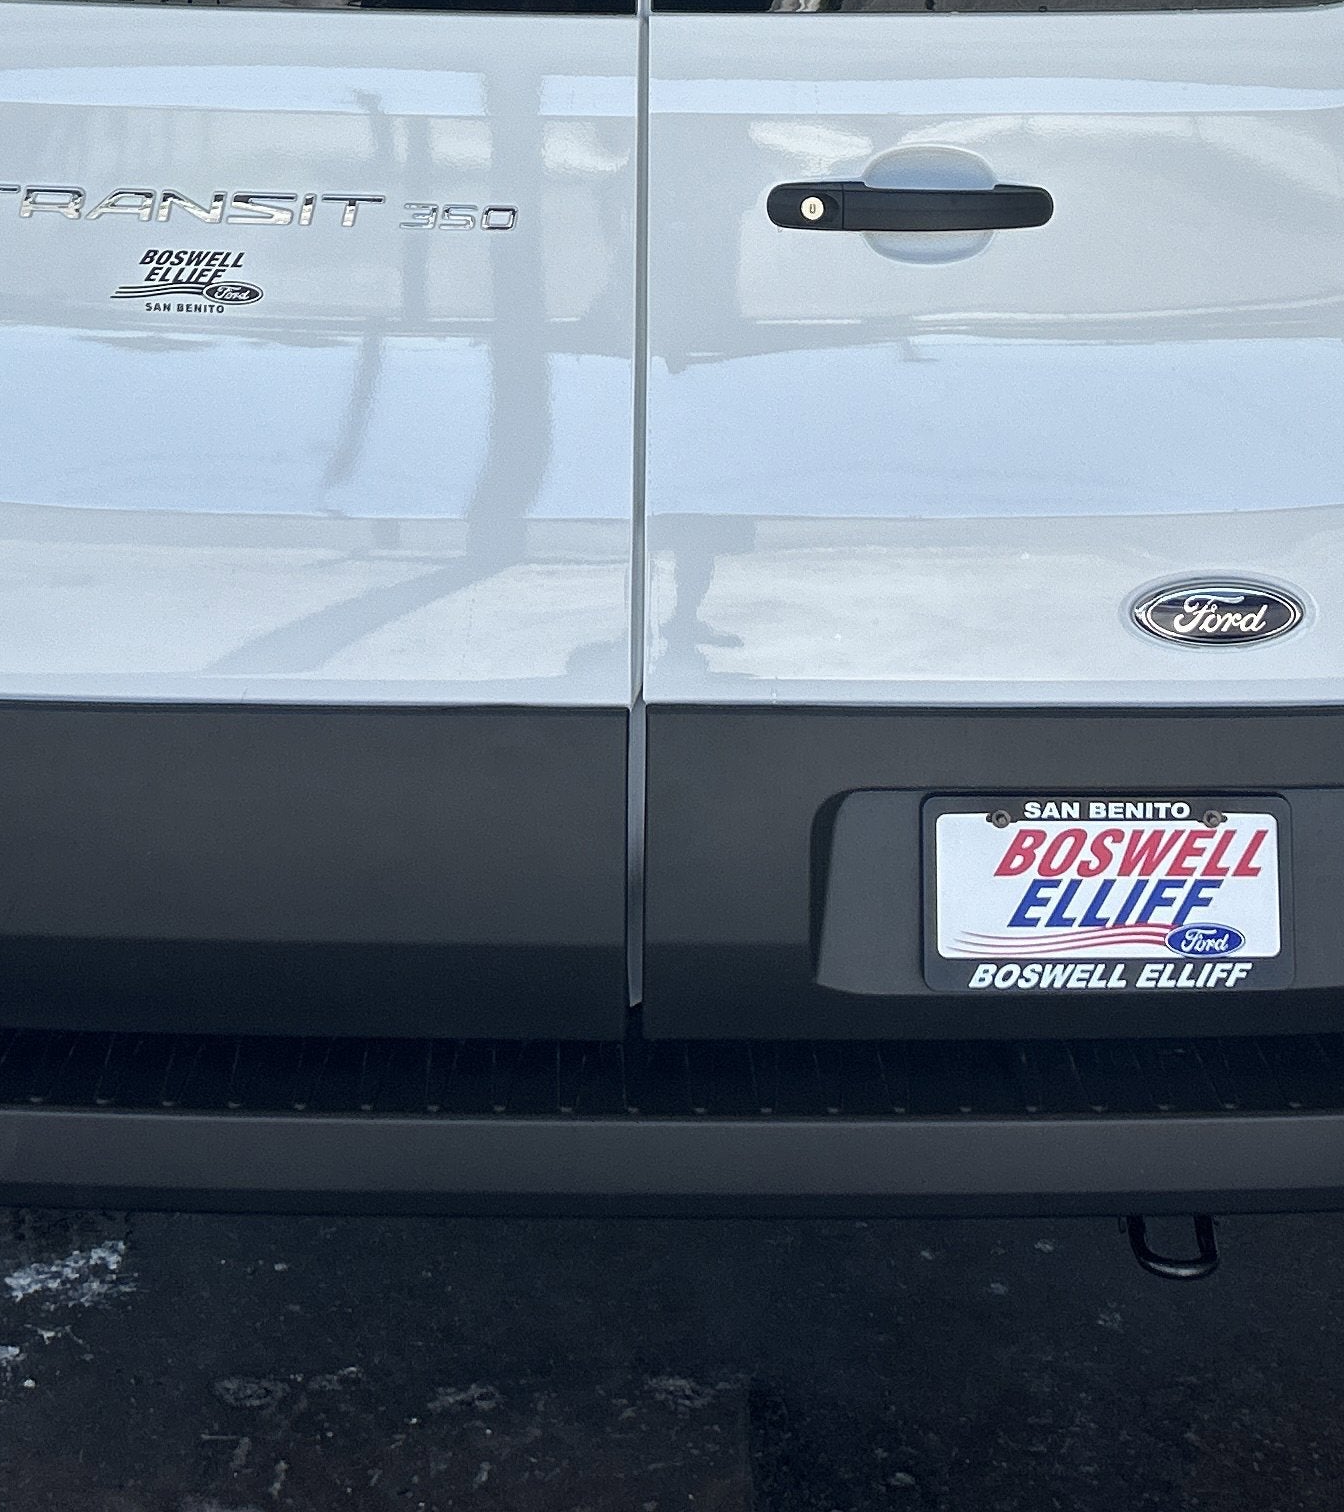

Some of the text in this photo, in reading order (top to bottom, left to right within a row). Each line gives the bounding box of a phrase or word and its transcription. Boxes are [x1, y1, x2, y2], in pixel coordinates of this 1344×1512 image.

[398, 202, 519, 231] 350
[139, 249, 245, 268] BOSWELL
[144, 267, 227, 285] ELLIFF
[214, 285, 250, 300] Ford
[145, 303, 225, 313] SAN BENITO
[1173, 594, 1269, 633] Ford
[1024, 801, 1191, 819] SAN BENITO
[993, 828, 1269, 877] BOSWELL
[1007, 879, 1223, 928] ELLIFF
[1180, 929, 1230, 953] Ford
[968, 962, 1253, 988] BOSWELL ELLIFF
